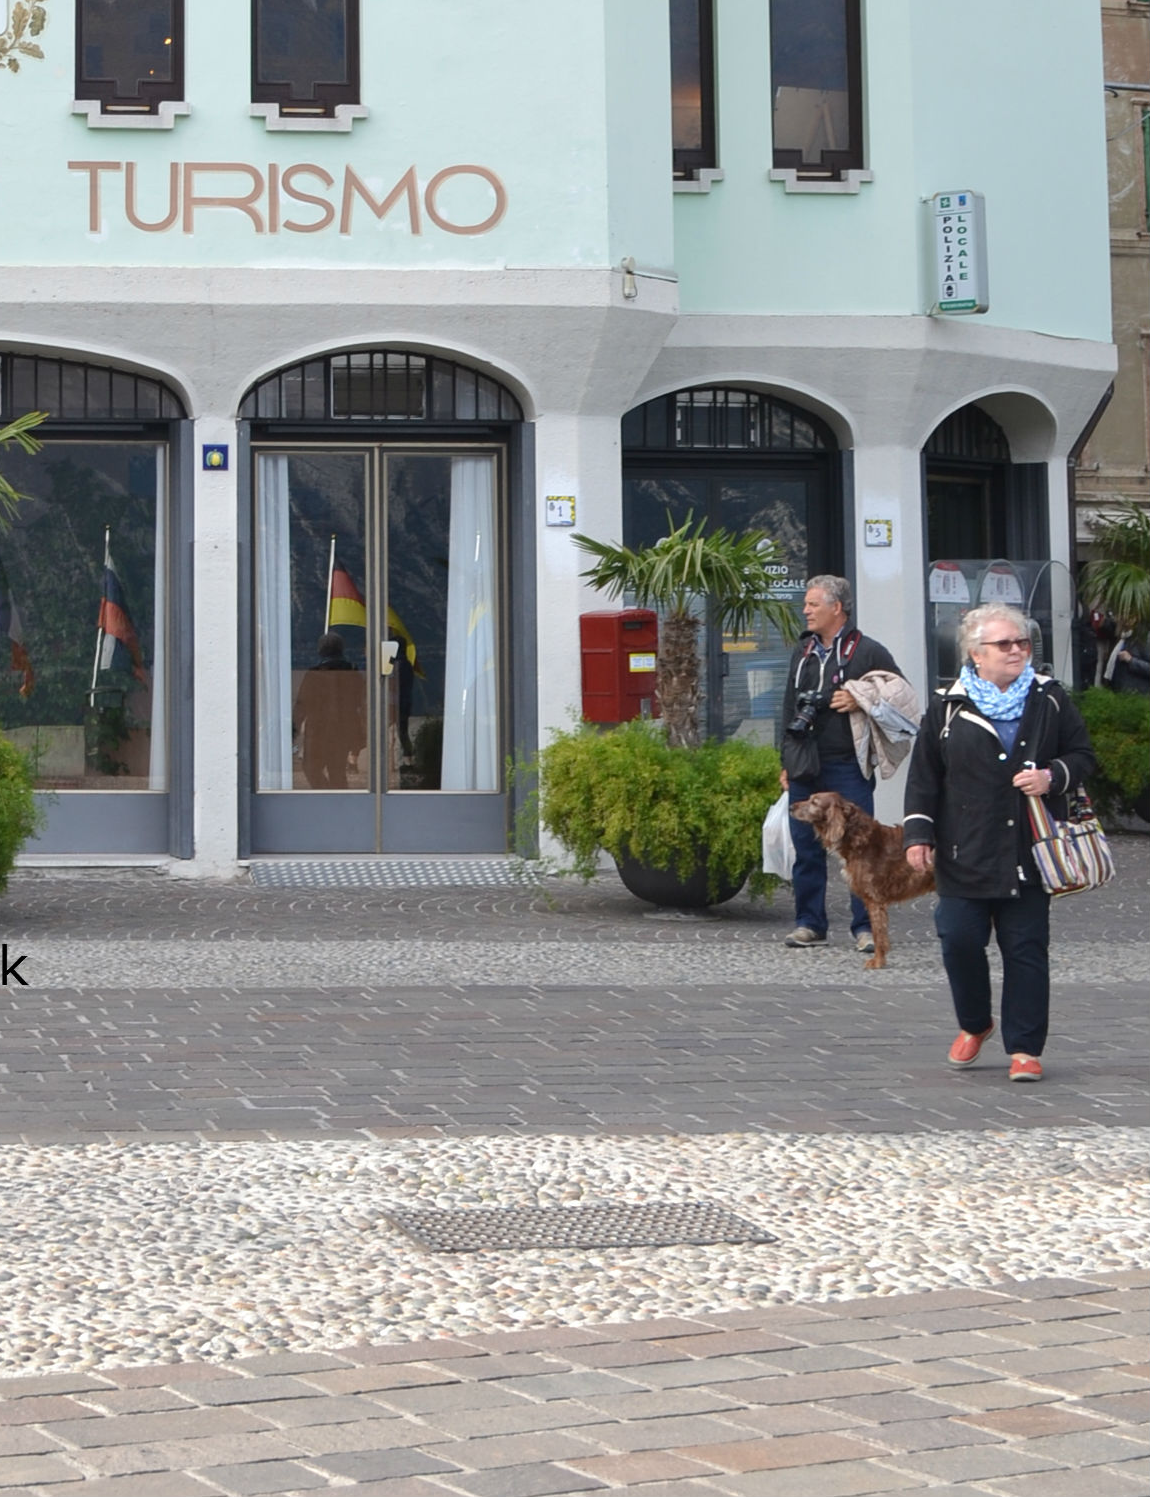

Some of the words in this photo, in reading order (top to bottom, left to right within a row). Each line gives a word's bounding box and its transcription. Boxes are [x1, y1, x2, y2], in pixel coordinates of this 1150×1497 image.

[67, 159, 508, 237] TURISMO
[942, 216, 954, 282] POLIZIA
[957, 215, 968, 281] LOCALE
